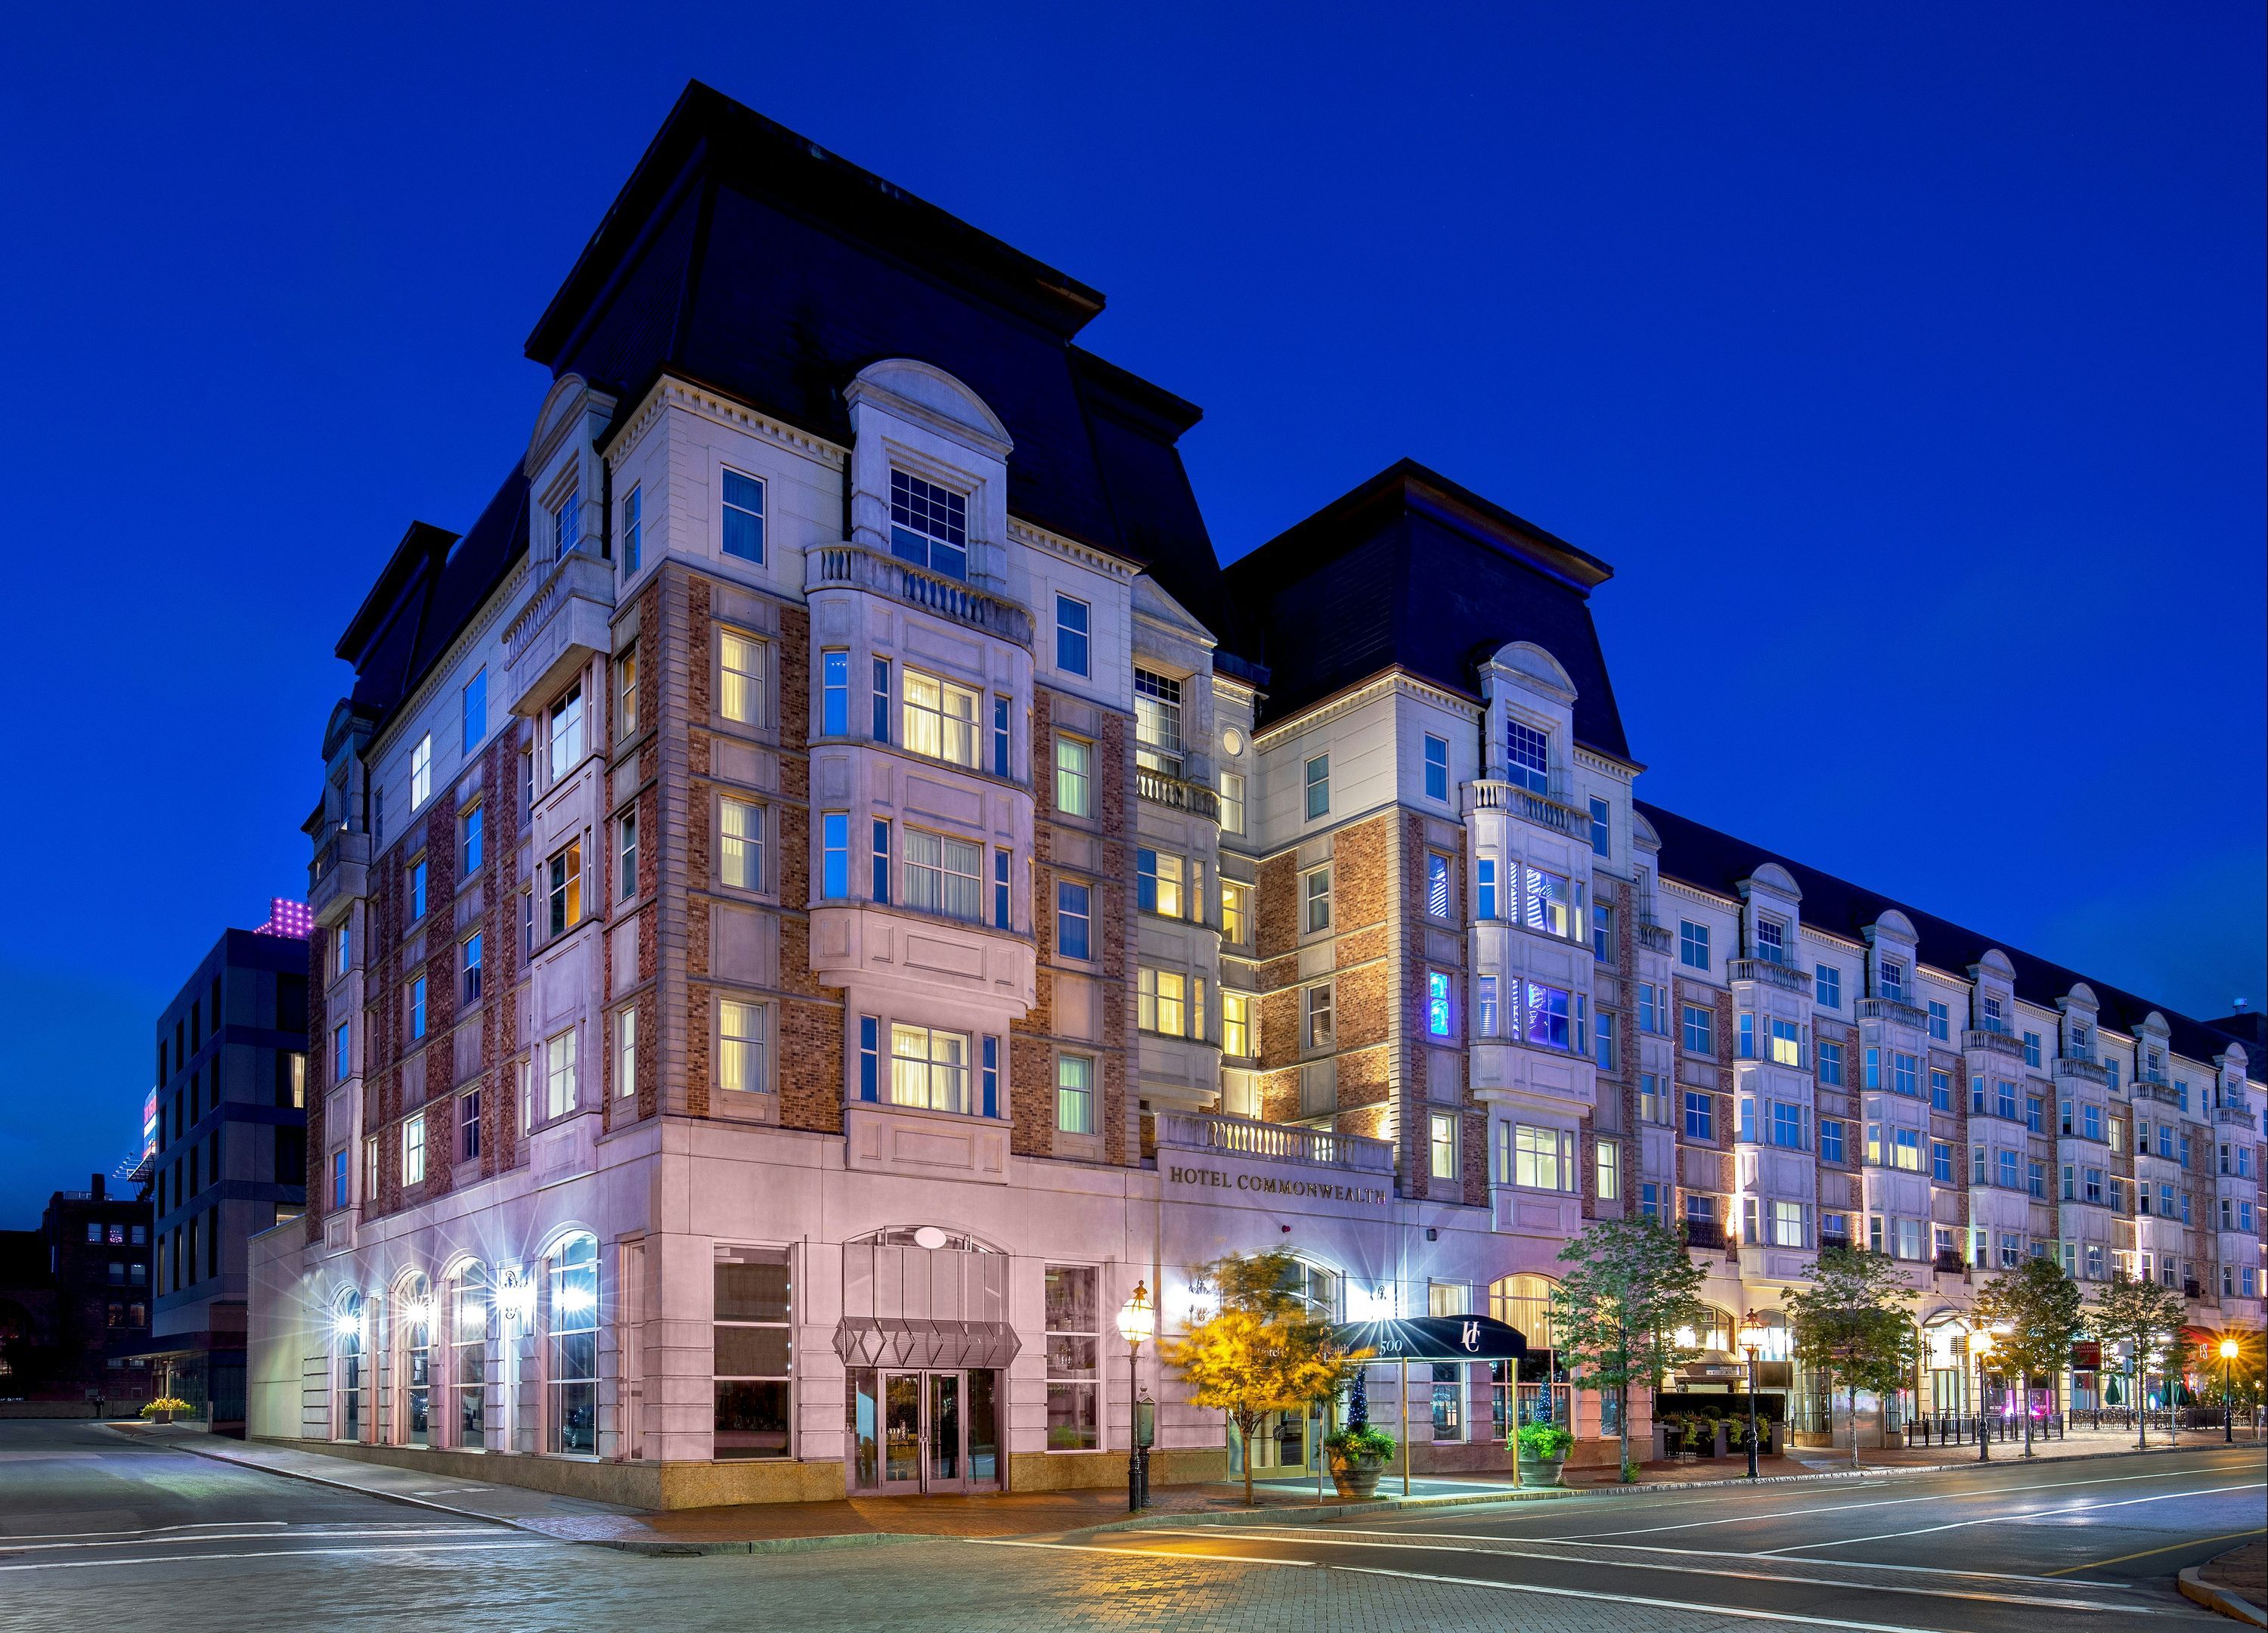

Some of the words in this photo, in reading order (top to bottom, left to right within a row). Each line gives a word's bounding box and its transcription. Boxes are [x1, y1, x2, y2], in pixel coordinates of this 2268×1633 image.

[1170, 1167, 1232, 1188] HOTEL
[1237, 1174, 1387, 1205] COMMONWEALTH
[1378, 1340, 1403, 1356] 500
[2199, 1343, 2208, 1359] ES
